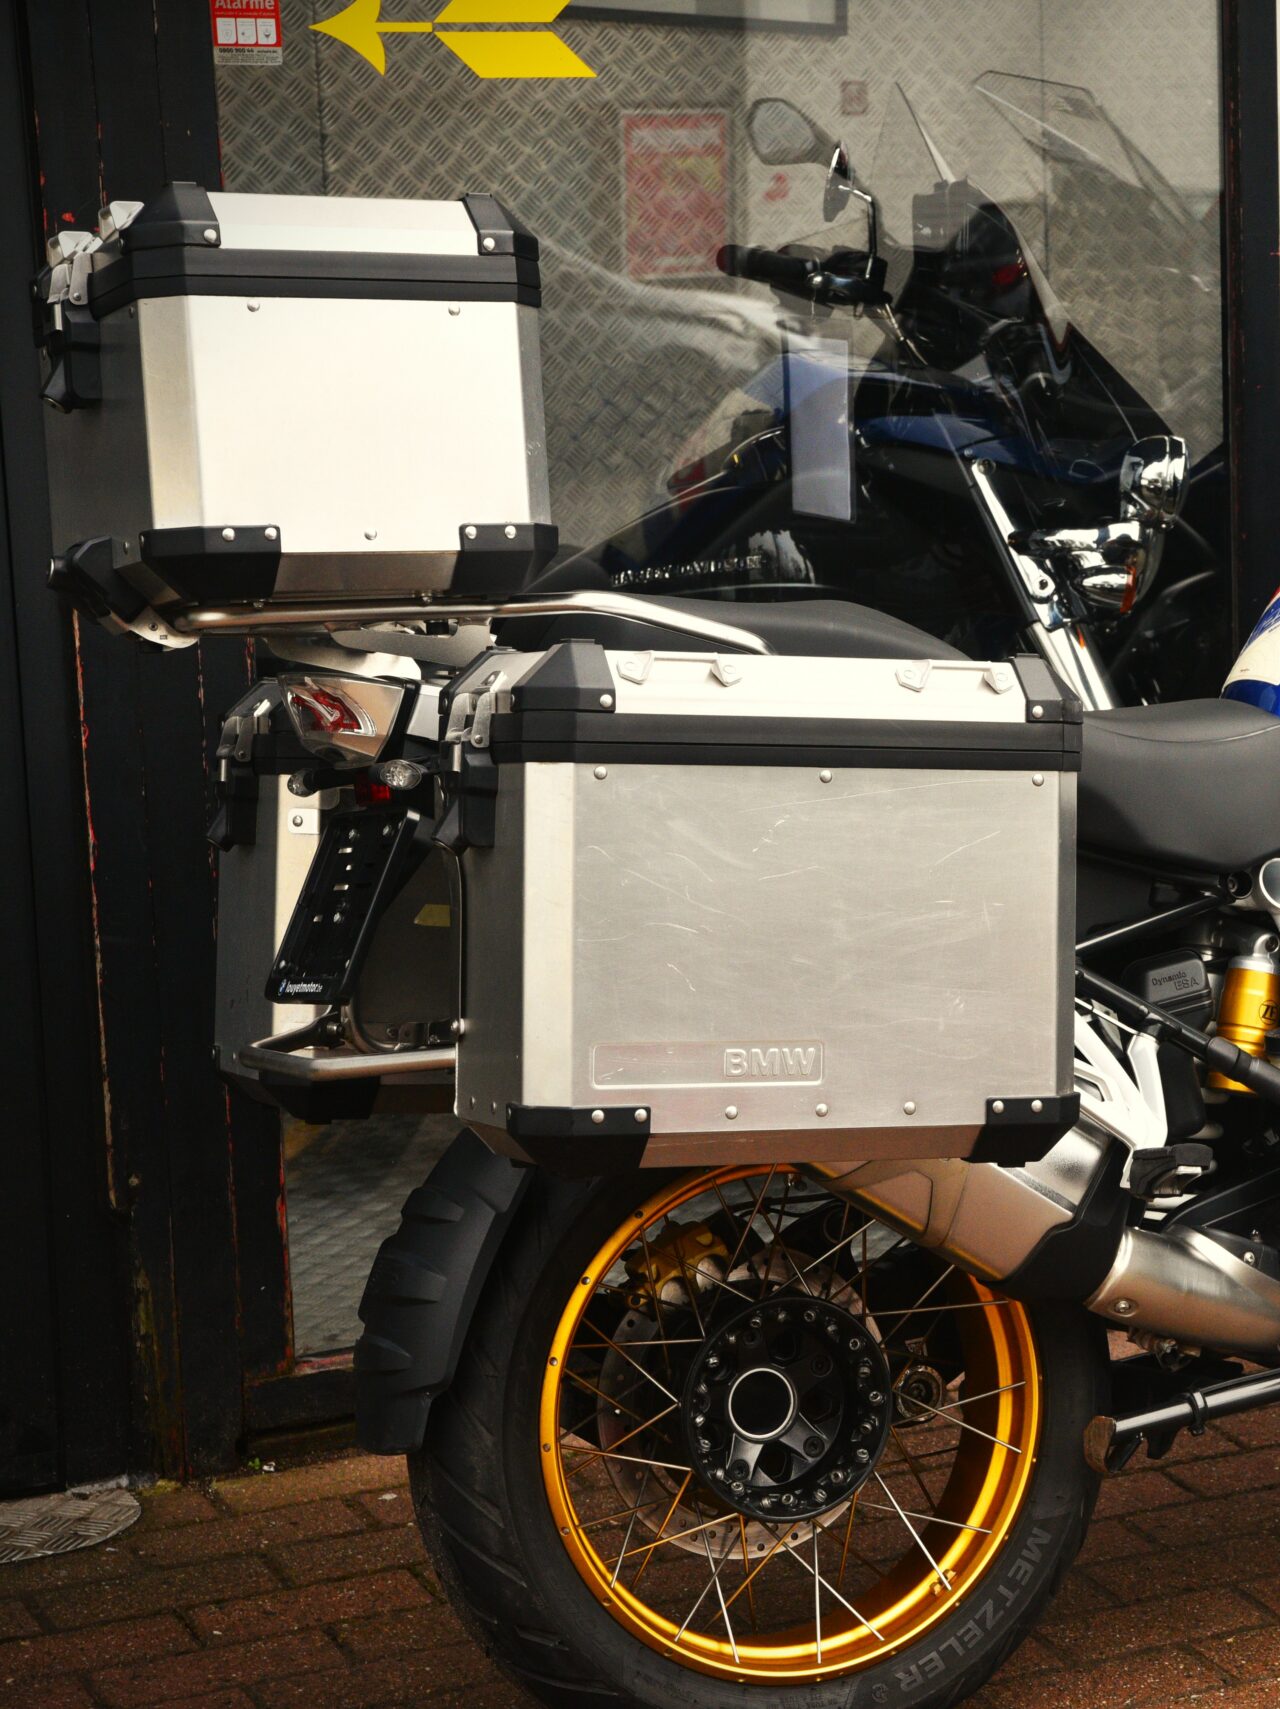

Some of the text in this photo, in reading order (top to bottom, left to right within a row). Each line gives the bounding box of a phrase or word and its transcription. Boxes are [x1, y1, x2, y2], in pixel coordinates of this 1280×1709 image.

[214, 0, 275, 10] Alarme
[1152, 971, 1187, 986] Dynamic
[1174, 976, 1200, 991] ESA
[723, 1047, 815, 1077] BMW
[895, 1527, 1052, 1692] METZELER
